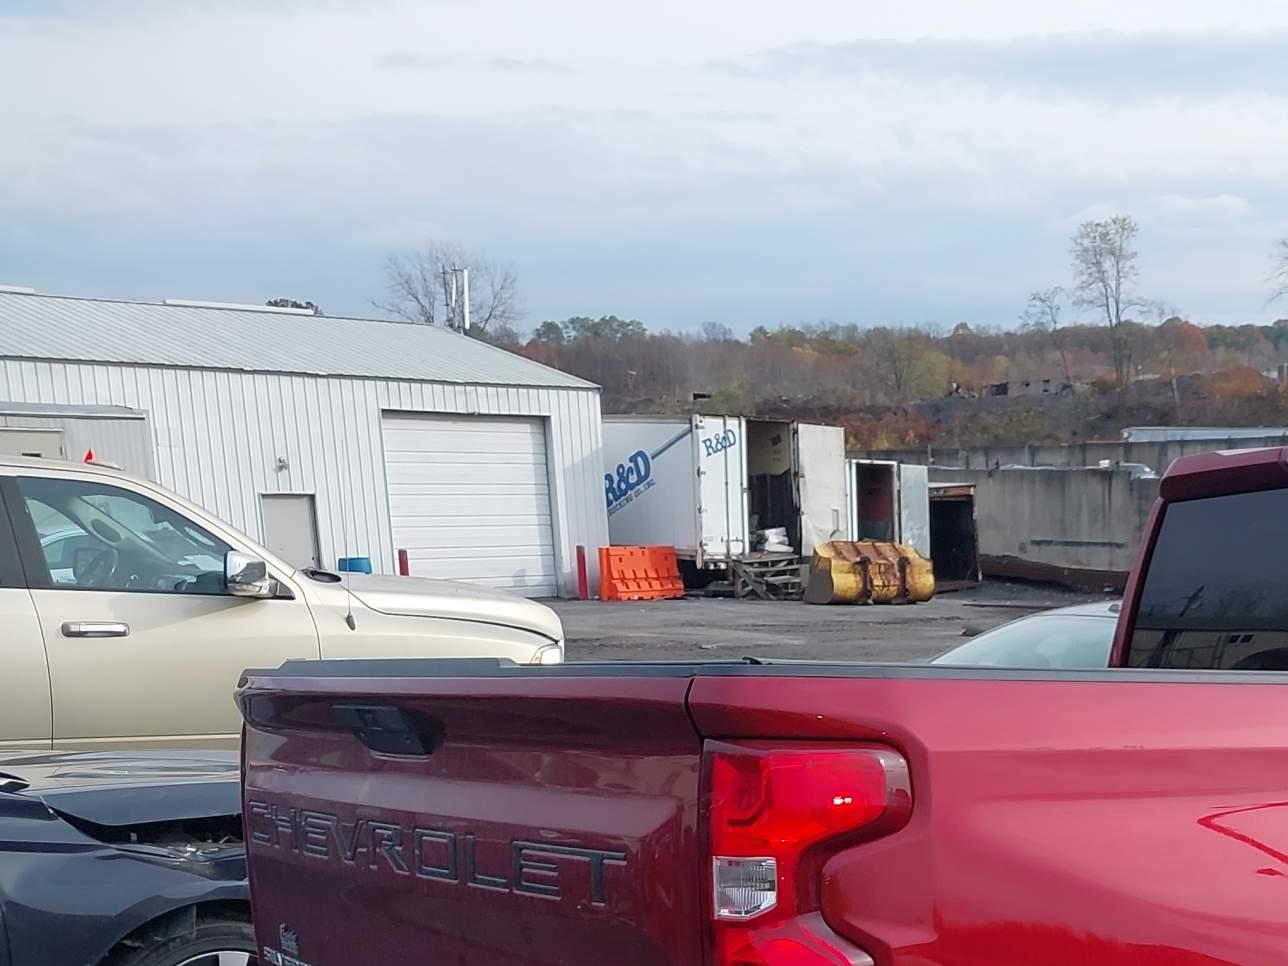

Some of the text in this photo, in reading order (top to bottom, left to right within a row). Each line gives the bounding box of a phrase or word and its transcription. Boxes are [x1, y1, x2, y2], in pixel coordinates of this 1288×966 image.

[702, 429, 737, 457] R&D
[604, 450, 651, 508] R&D
[248, 799, 627, 907] CHEVROLET
